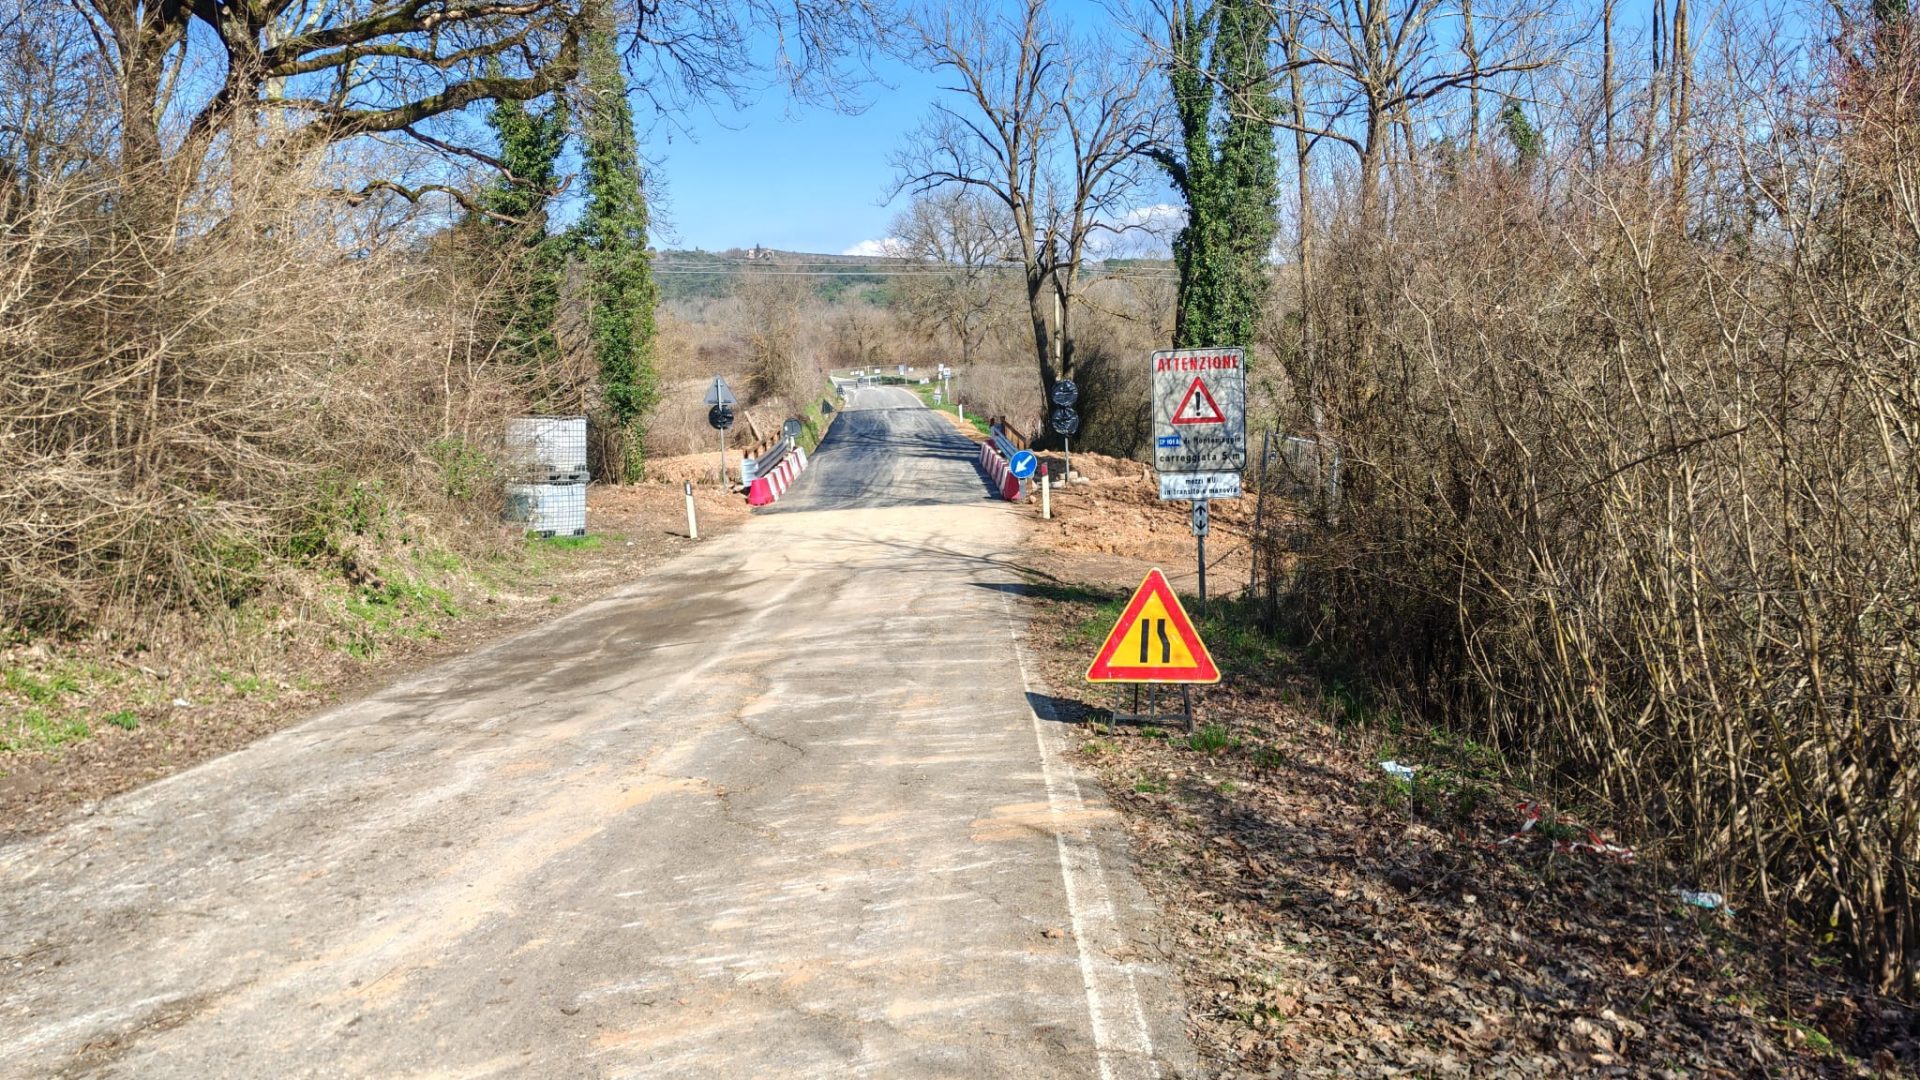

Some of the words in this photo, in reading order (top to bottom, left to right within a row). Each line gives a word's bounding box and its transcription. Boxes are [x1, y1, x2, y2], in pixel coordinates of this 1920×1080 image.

[1157, 355, 1239, 372] ATTENZIONE
[1159, 452, 1217, 463] carreggiata
[1222, 451, 1228, 461] 5
[1232, 452, 1240, 460] m
[1173, 488, 1200, 496] transito
